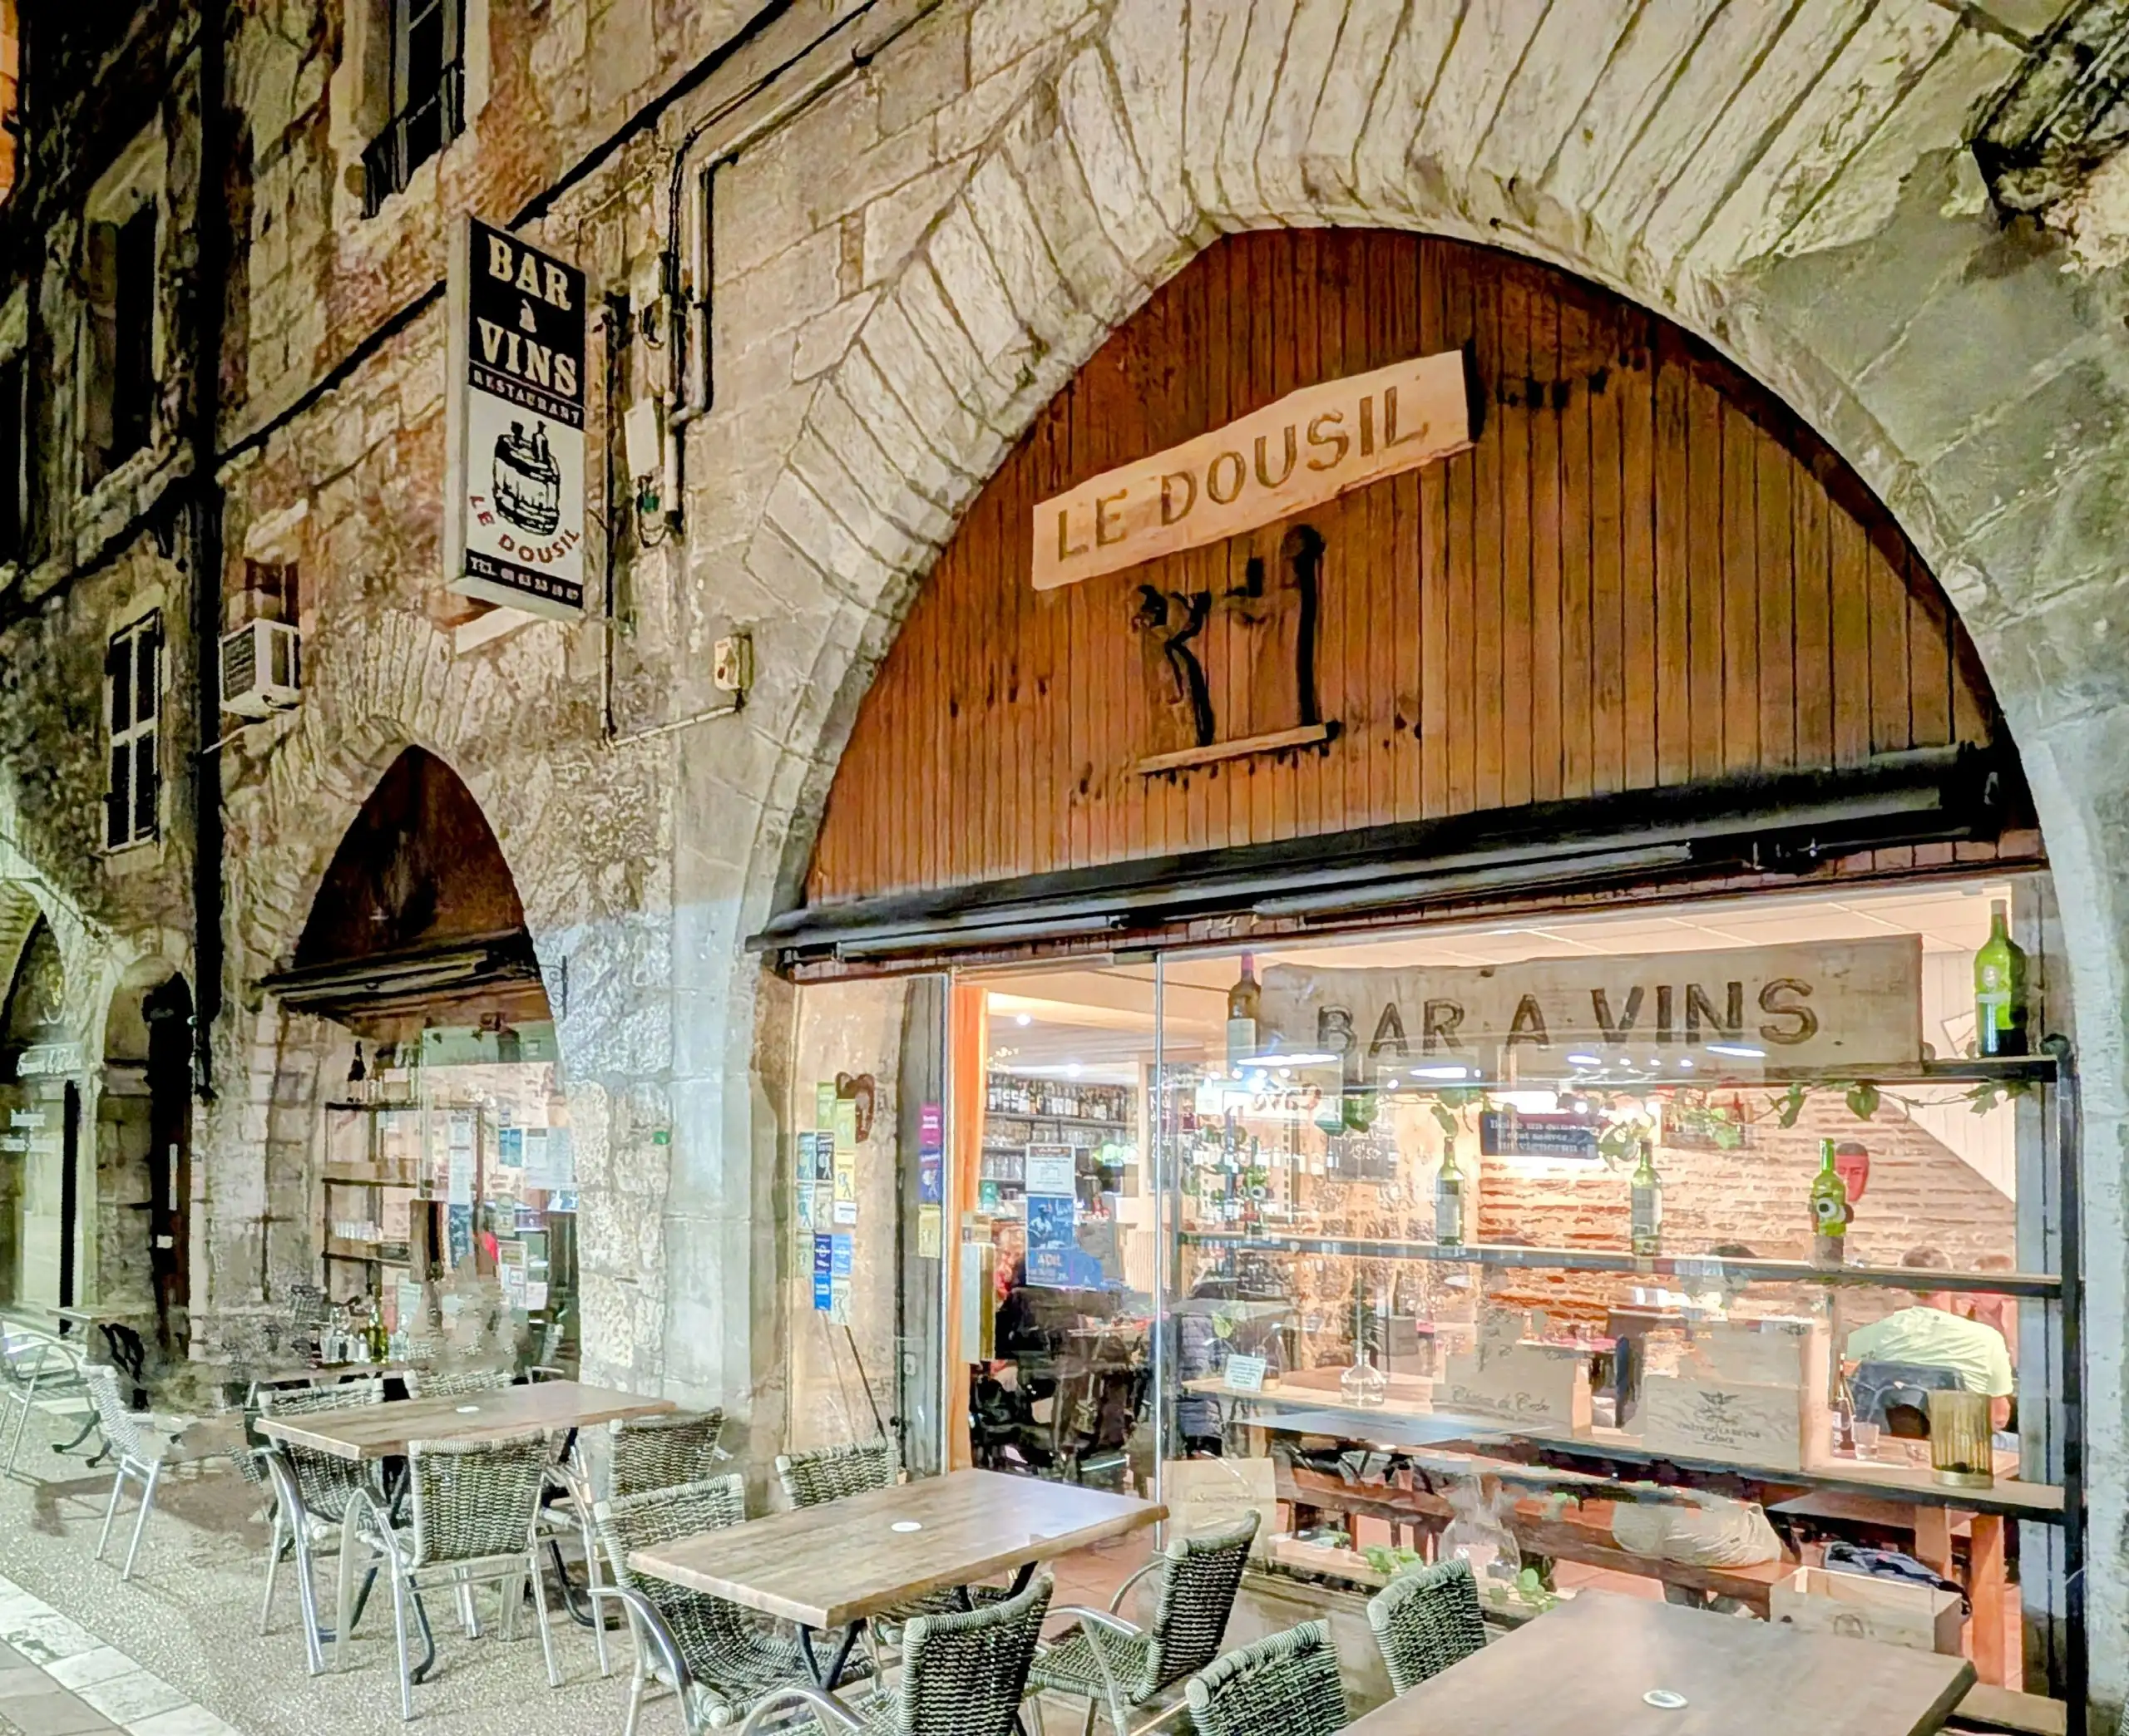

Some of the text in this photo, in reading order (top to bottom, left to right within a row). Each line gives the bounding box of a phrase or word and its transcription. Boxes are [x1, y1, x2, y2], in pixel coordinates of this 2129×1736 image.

[487, 233, 572, 312] BAR
[477, 317, 577, 397] VINS
[473, 369, 580, 425] RESTAURANT
[1057, 385, 1430, 563] LE DOUSIL
[469, 495, 580, 564] LE DOUSIL
[1317, 998, 1464, 1058] BAR
[1590, 977, 1819, 1046] VINS
